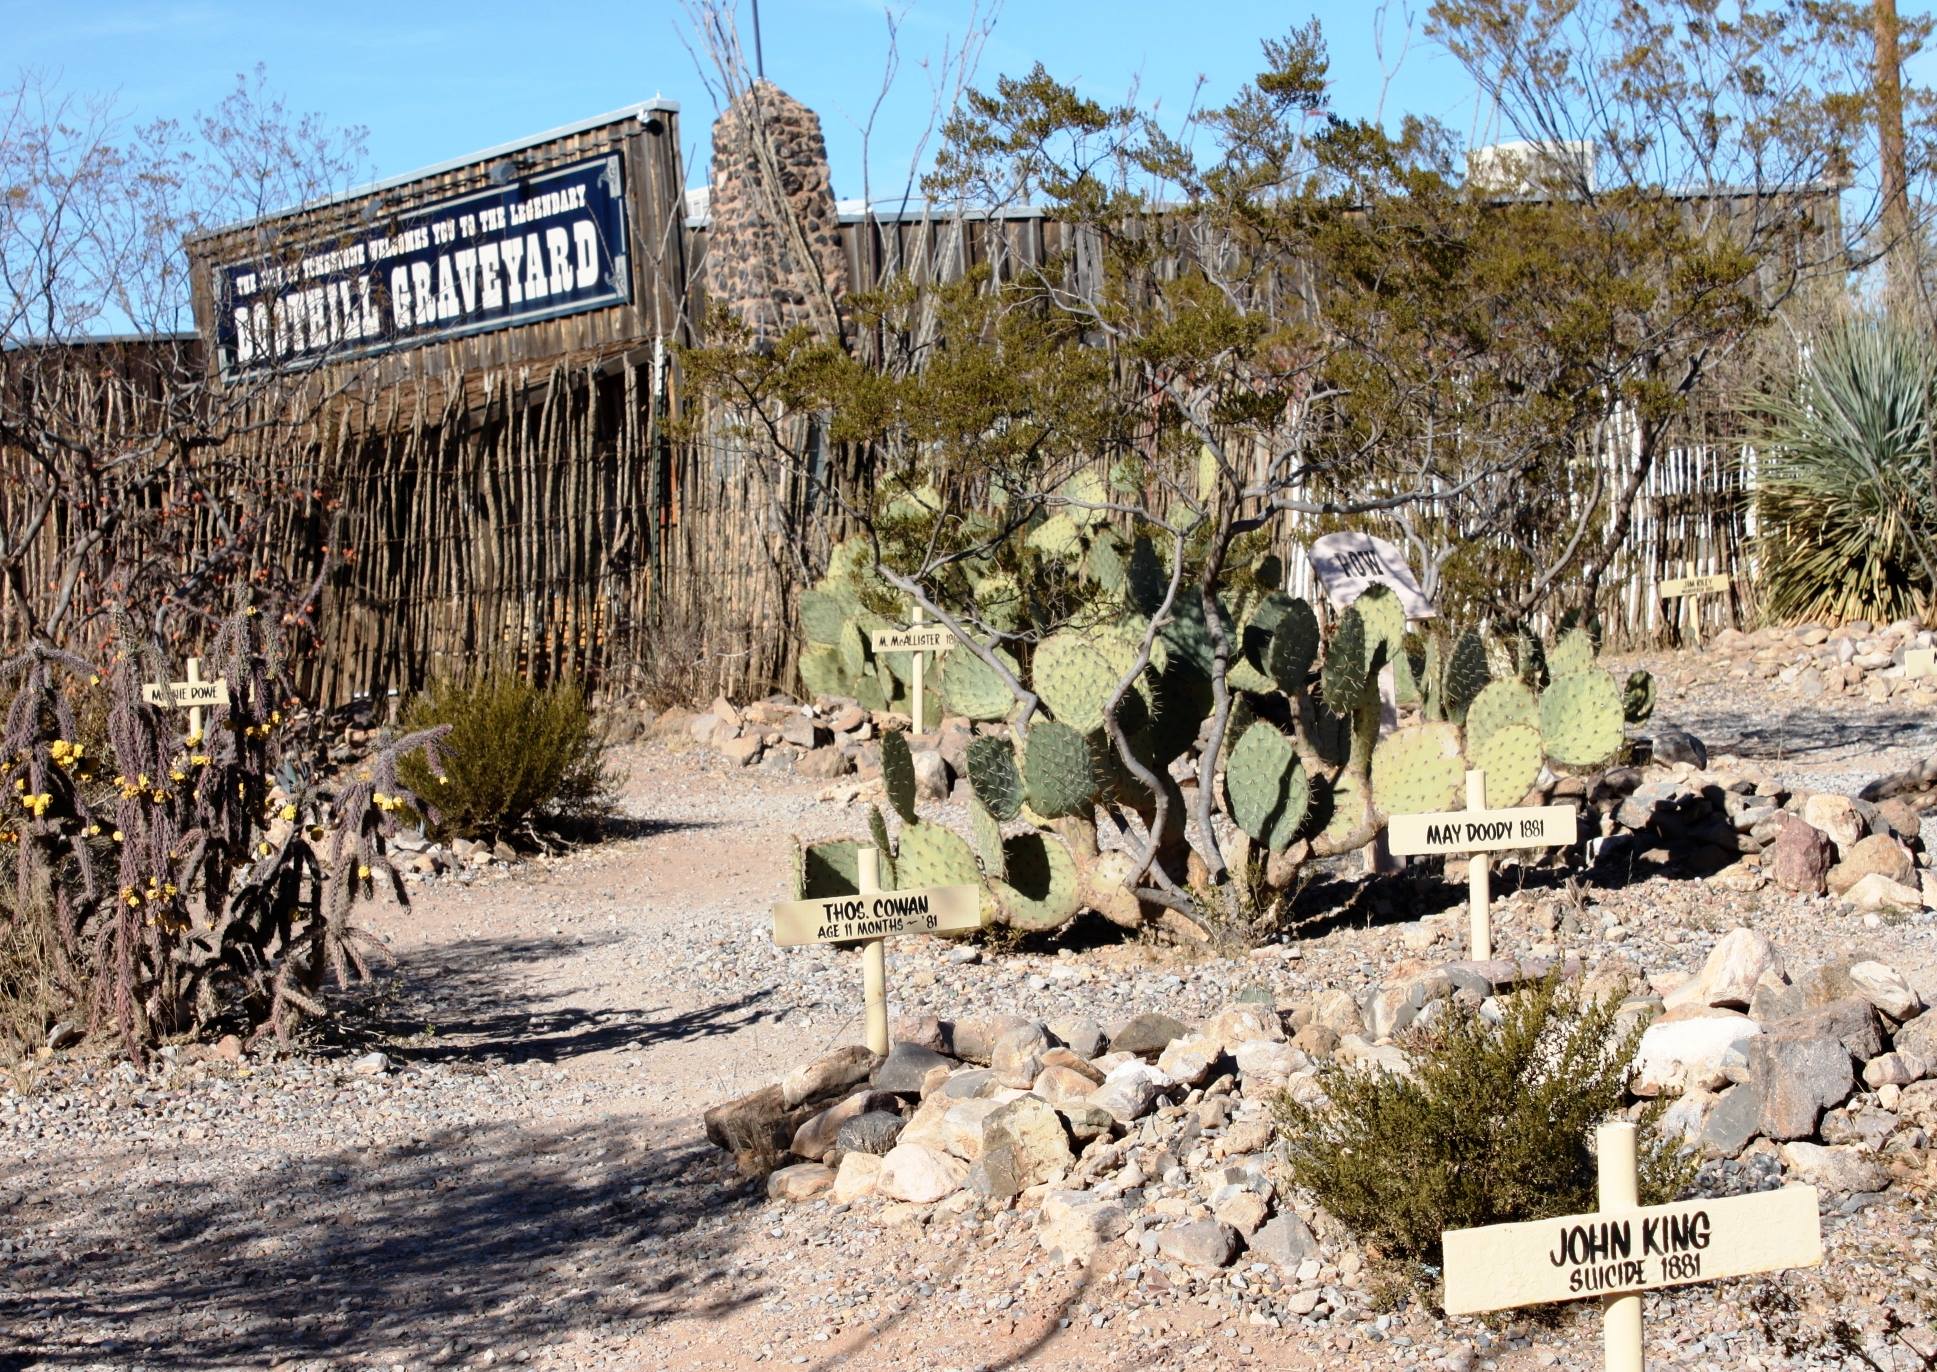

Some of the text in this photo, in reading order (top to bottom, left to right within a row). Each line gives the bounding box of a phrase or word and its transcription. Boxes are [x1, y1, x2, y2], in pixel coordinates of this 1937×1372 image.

[236, 273, 257, 296] THE
[369, 227, 430, 262] WELCOMES
[432, 219, 456, 245] YOU
[459, 213, 476, 238] TO
[479, 206, 506, 232] THE
[510, 184, 587, 226] LEGENDARY
[234, 219, 600, 362] BOOTHILL GRAVEYARD
[152, 687, 187, 702] MNIE
[1426, 819, 1544, 845] MAY DOODY 1881
[823, 895, 929, 924] THOS. COWAN
[817, 924, 840, 939] AGE
[844, 923, 853, 937] 11
[857, 918, 904, 937] MONTHS
[1549, 1210, 1712, 1268] JOHN KING
[1568, 1252, 1701, 1293] SUICIDE 1881
